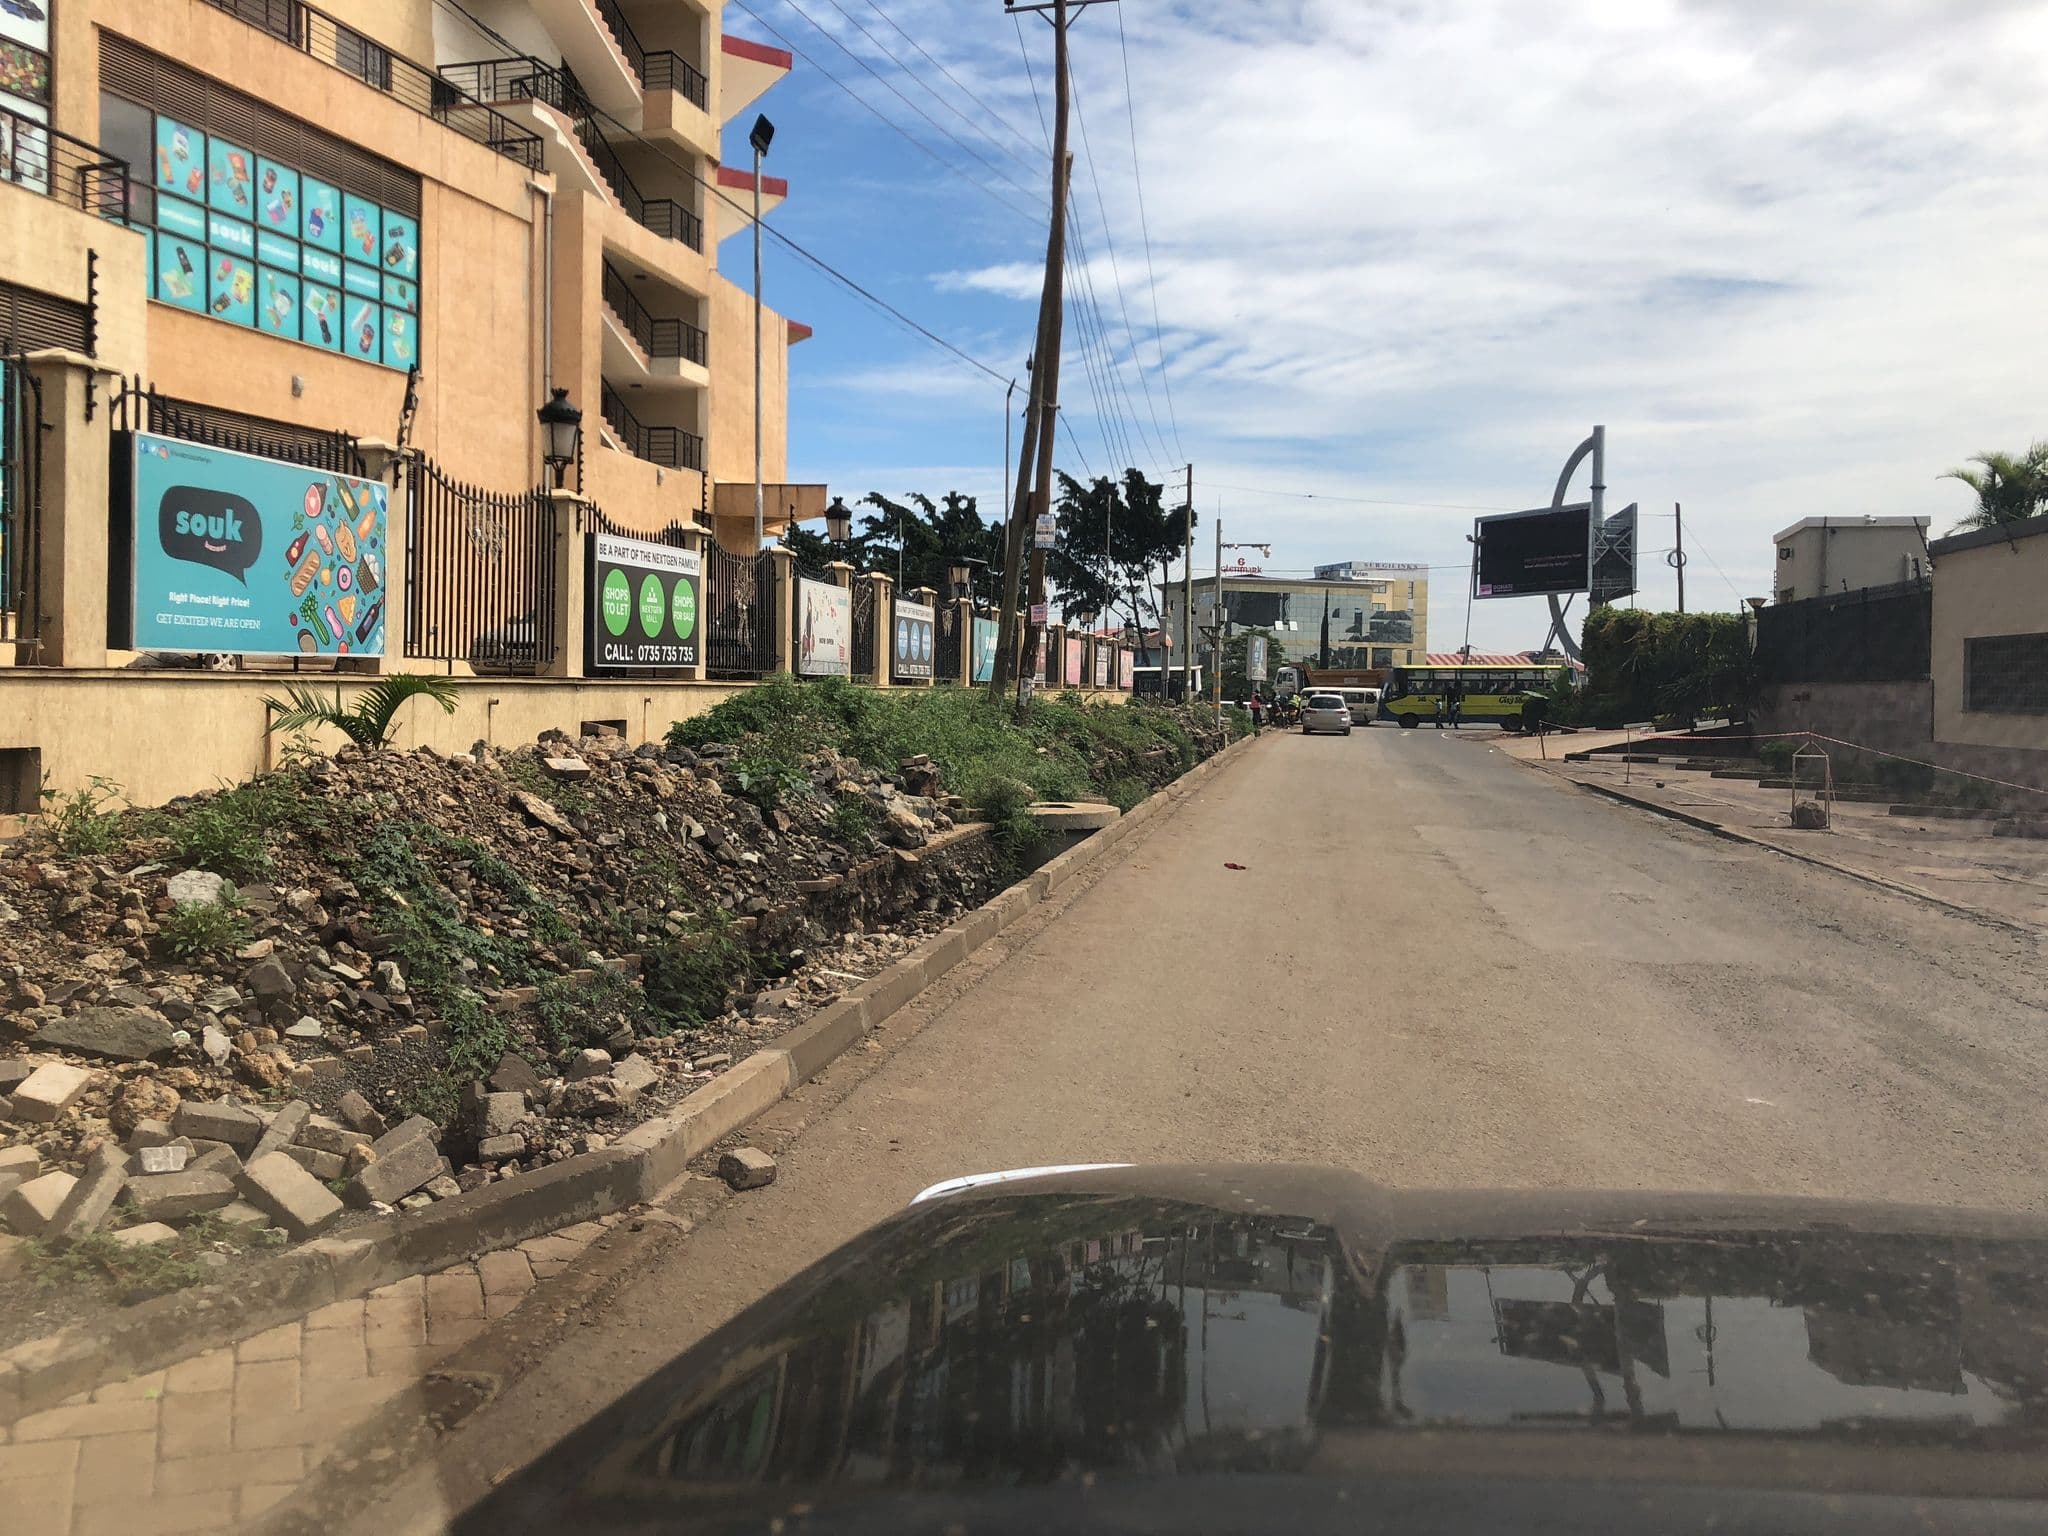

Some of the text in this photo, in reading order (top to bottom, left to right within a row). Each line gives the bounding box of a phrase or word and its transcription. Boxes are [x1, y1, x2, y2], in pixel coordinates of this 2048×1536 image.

[210, 221, 252, 246] souk
[303, 253, 340, 276] souk
[175, 508, 243, 542] souk
[599, 542, 607, 556] BE
[608, 545, 613, 557] A
[614, 545, 630, 559] PART
[631, 548, 639, 560] OF
[640, 550, 651, 562] THE
[652, 552, 678, 567] NEXTGEN
[168, 591, 250, 608] Right Place! Right Price!
[605, 587, 628, 601] SHOPS
[673, 595, 694, 609] SHOPS
[605, 602, 629, 617] TO LET
[641, 605, 663, 614] NEXTGEN
[673, 611, 695, 622] FOR SALE
[156, 613, 173, 624] GET
[209, 617, 223, 627] WE
[223, 618, 239, 628] ARE
[604, 643, 694, 662] CALL: 0735 735 735
